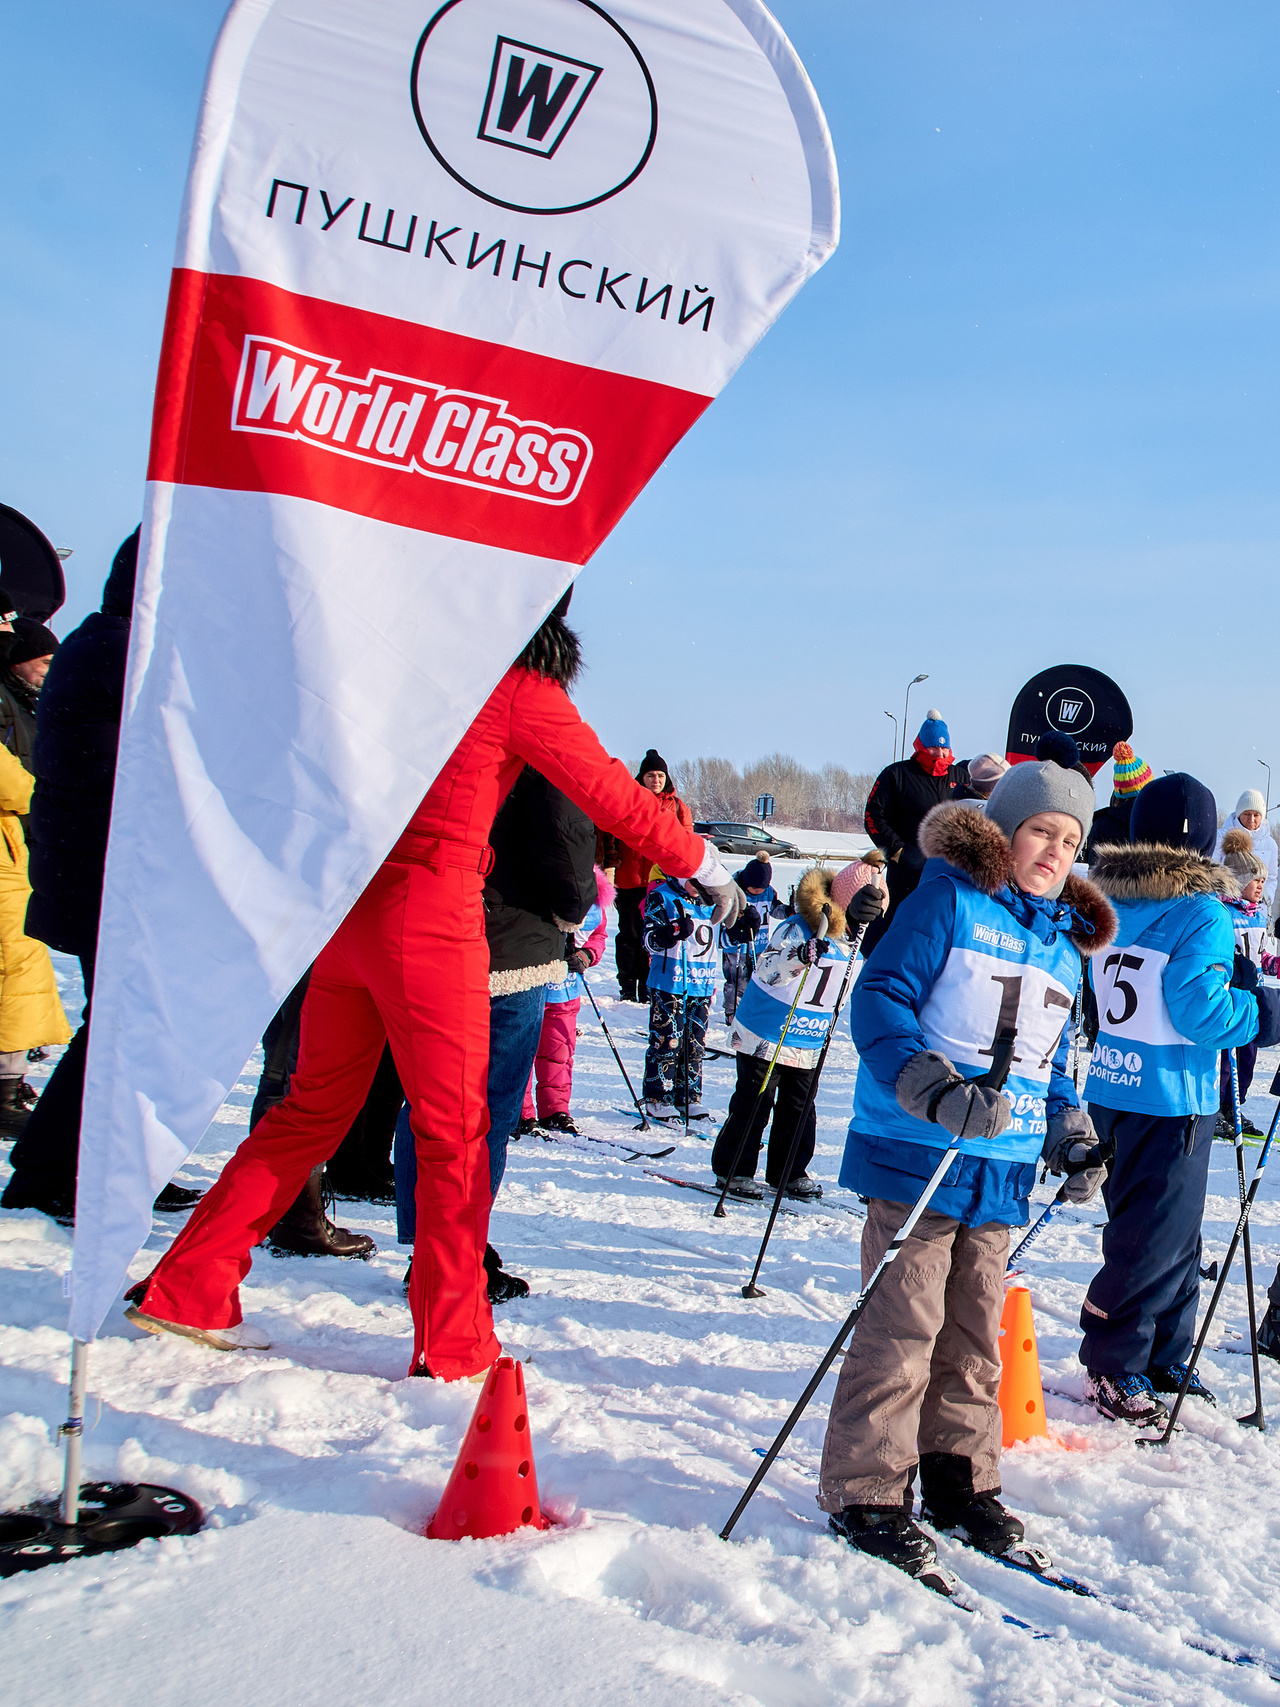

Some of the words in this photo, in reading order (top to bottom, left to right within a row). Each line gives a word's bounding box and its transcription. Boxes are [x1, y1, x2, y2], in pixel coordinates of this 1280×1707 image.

[496, 54, 579, 142] W
[266, 179, 716, 333] ПУШКИНСКИЙ
[245, 349, 427, 458] World
[422, 400, 581, 497] Class
[1021, 733, 1107, 752] ПУСКИЙ
[975, 926, 1001, 946] World
[1000, 932, 1025, 952] Class
[978, 975, 1072, 1069] 17
[1028, 1119, 1047, 1135] TEA
[1235, 1201, 1252, 1237] NORDWAY
